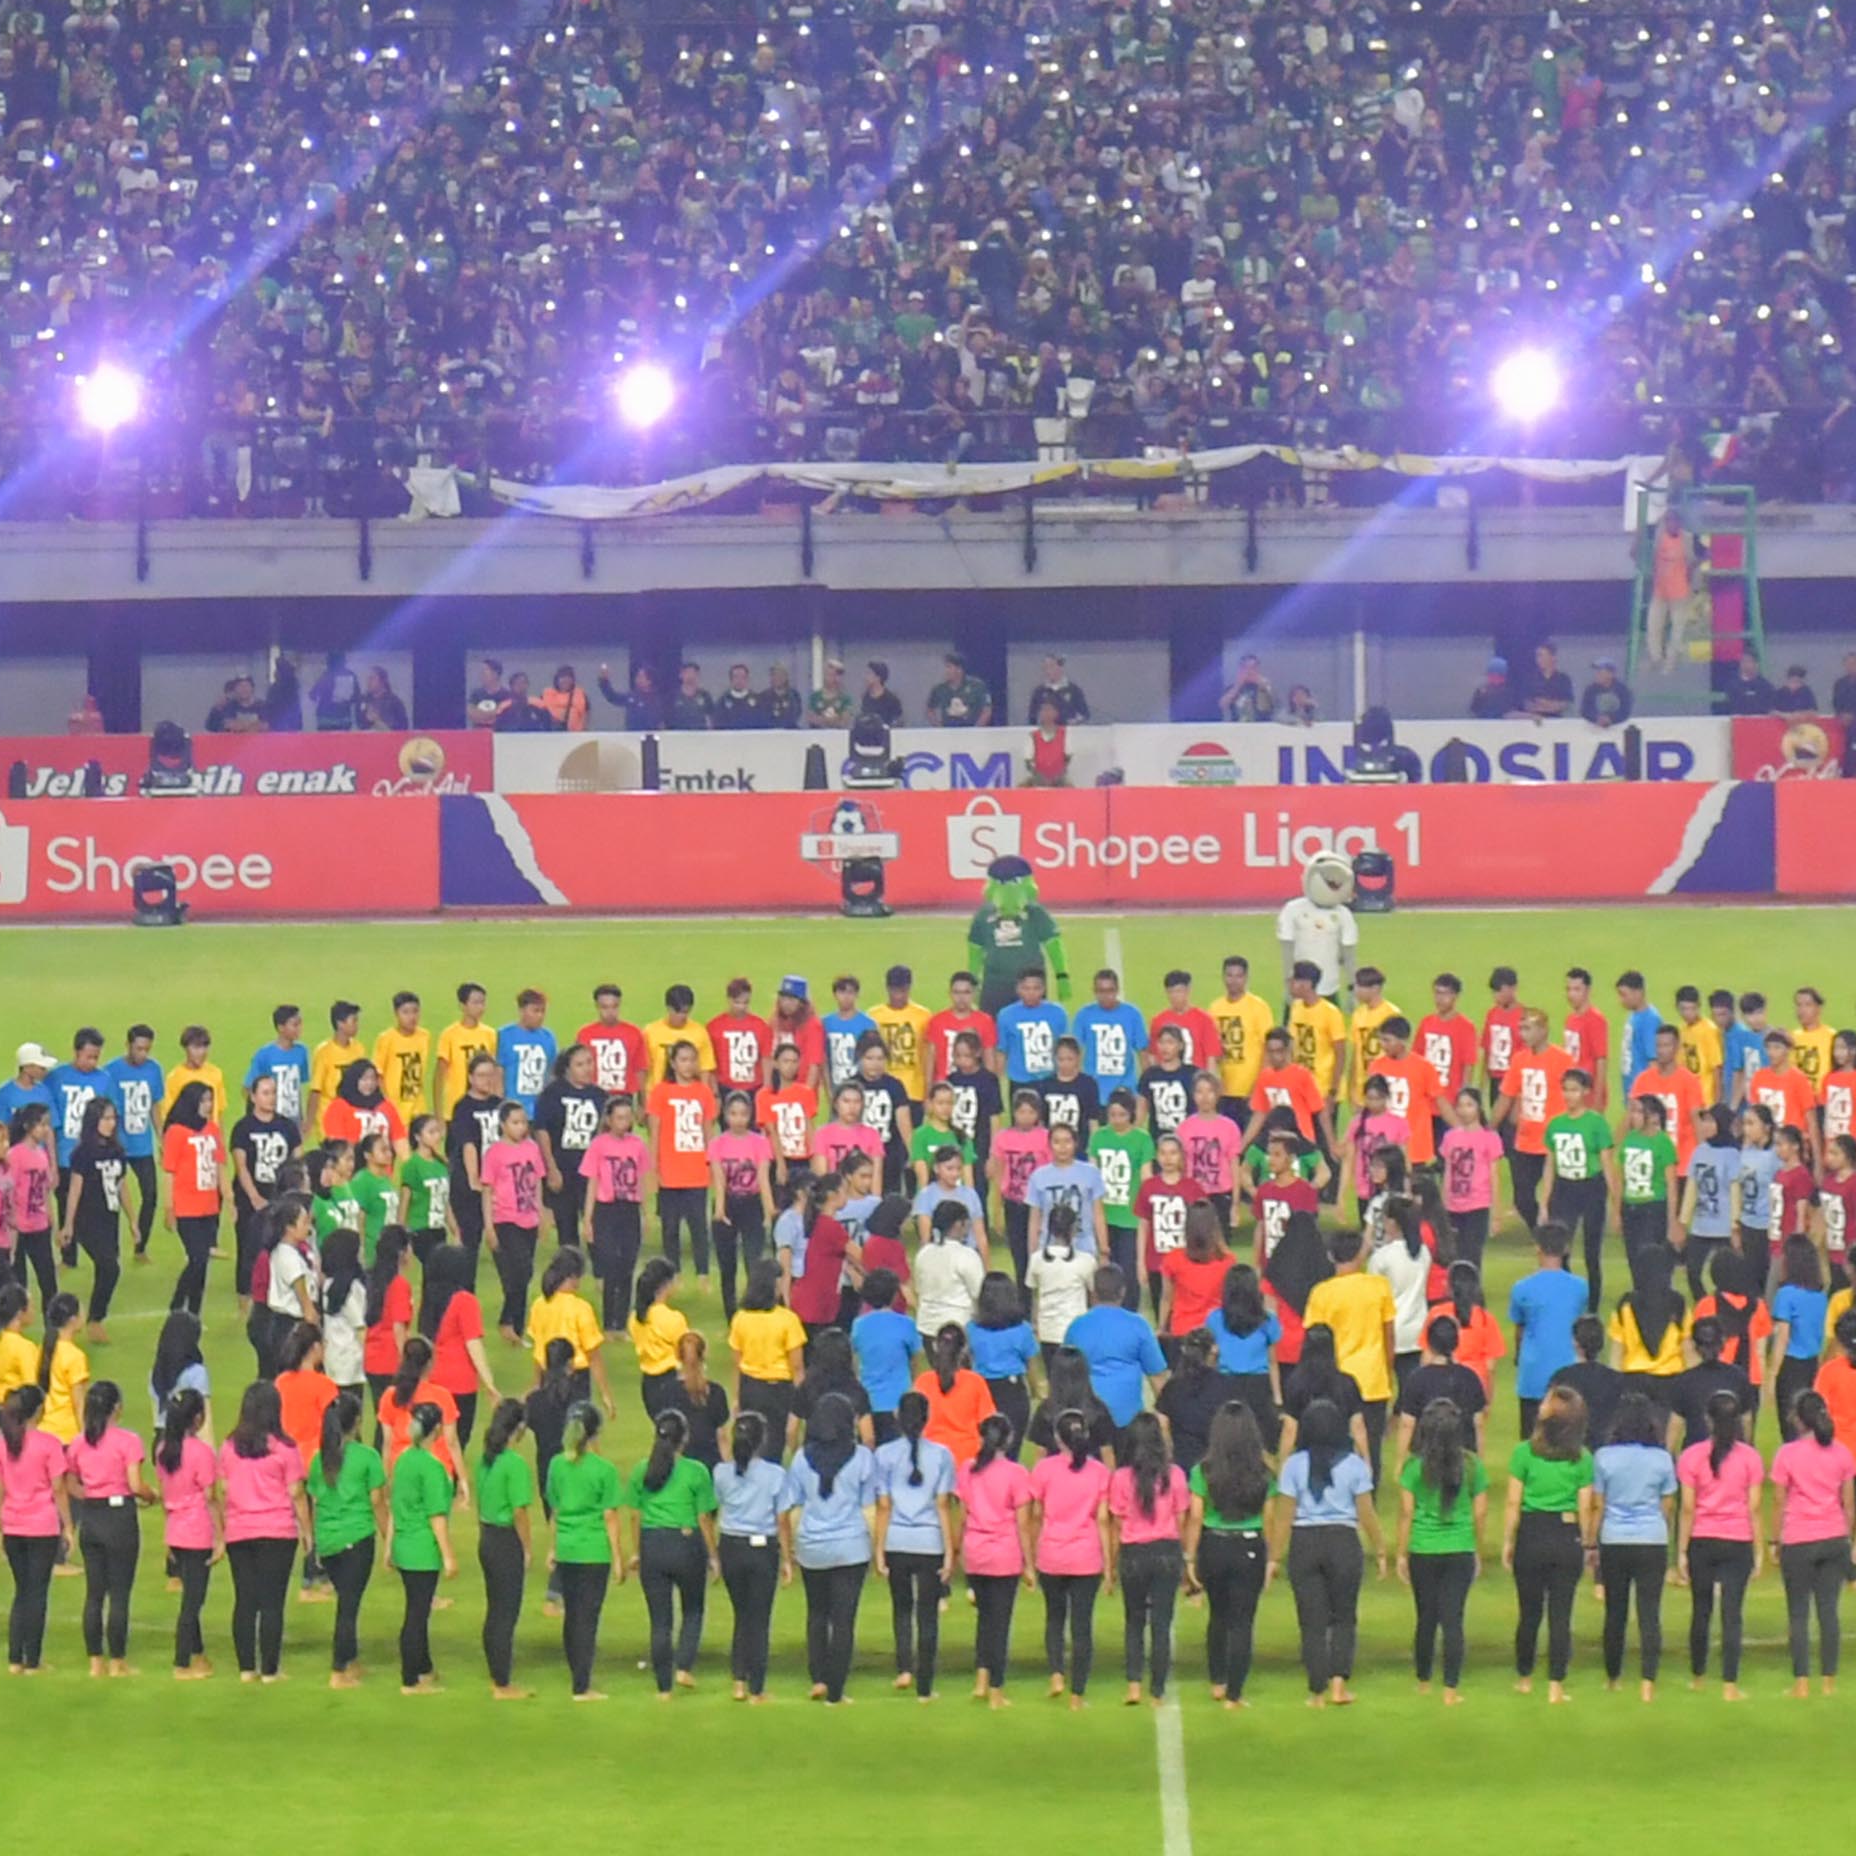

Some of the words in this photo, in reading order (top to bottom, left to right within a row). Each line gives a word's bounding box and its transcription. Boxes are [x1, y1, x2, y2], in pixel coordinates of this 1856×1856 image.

[25, 766, 127, 798] Jels
[257, 763, 357, 794] enak
[842, 751, 1012, 791] CM
[1034, 821, 1221, 879] Shopee
[1394, 810, 1421, 867] 1
